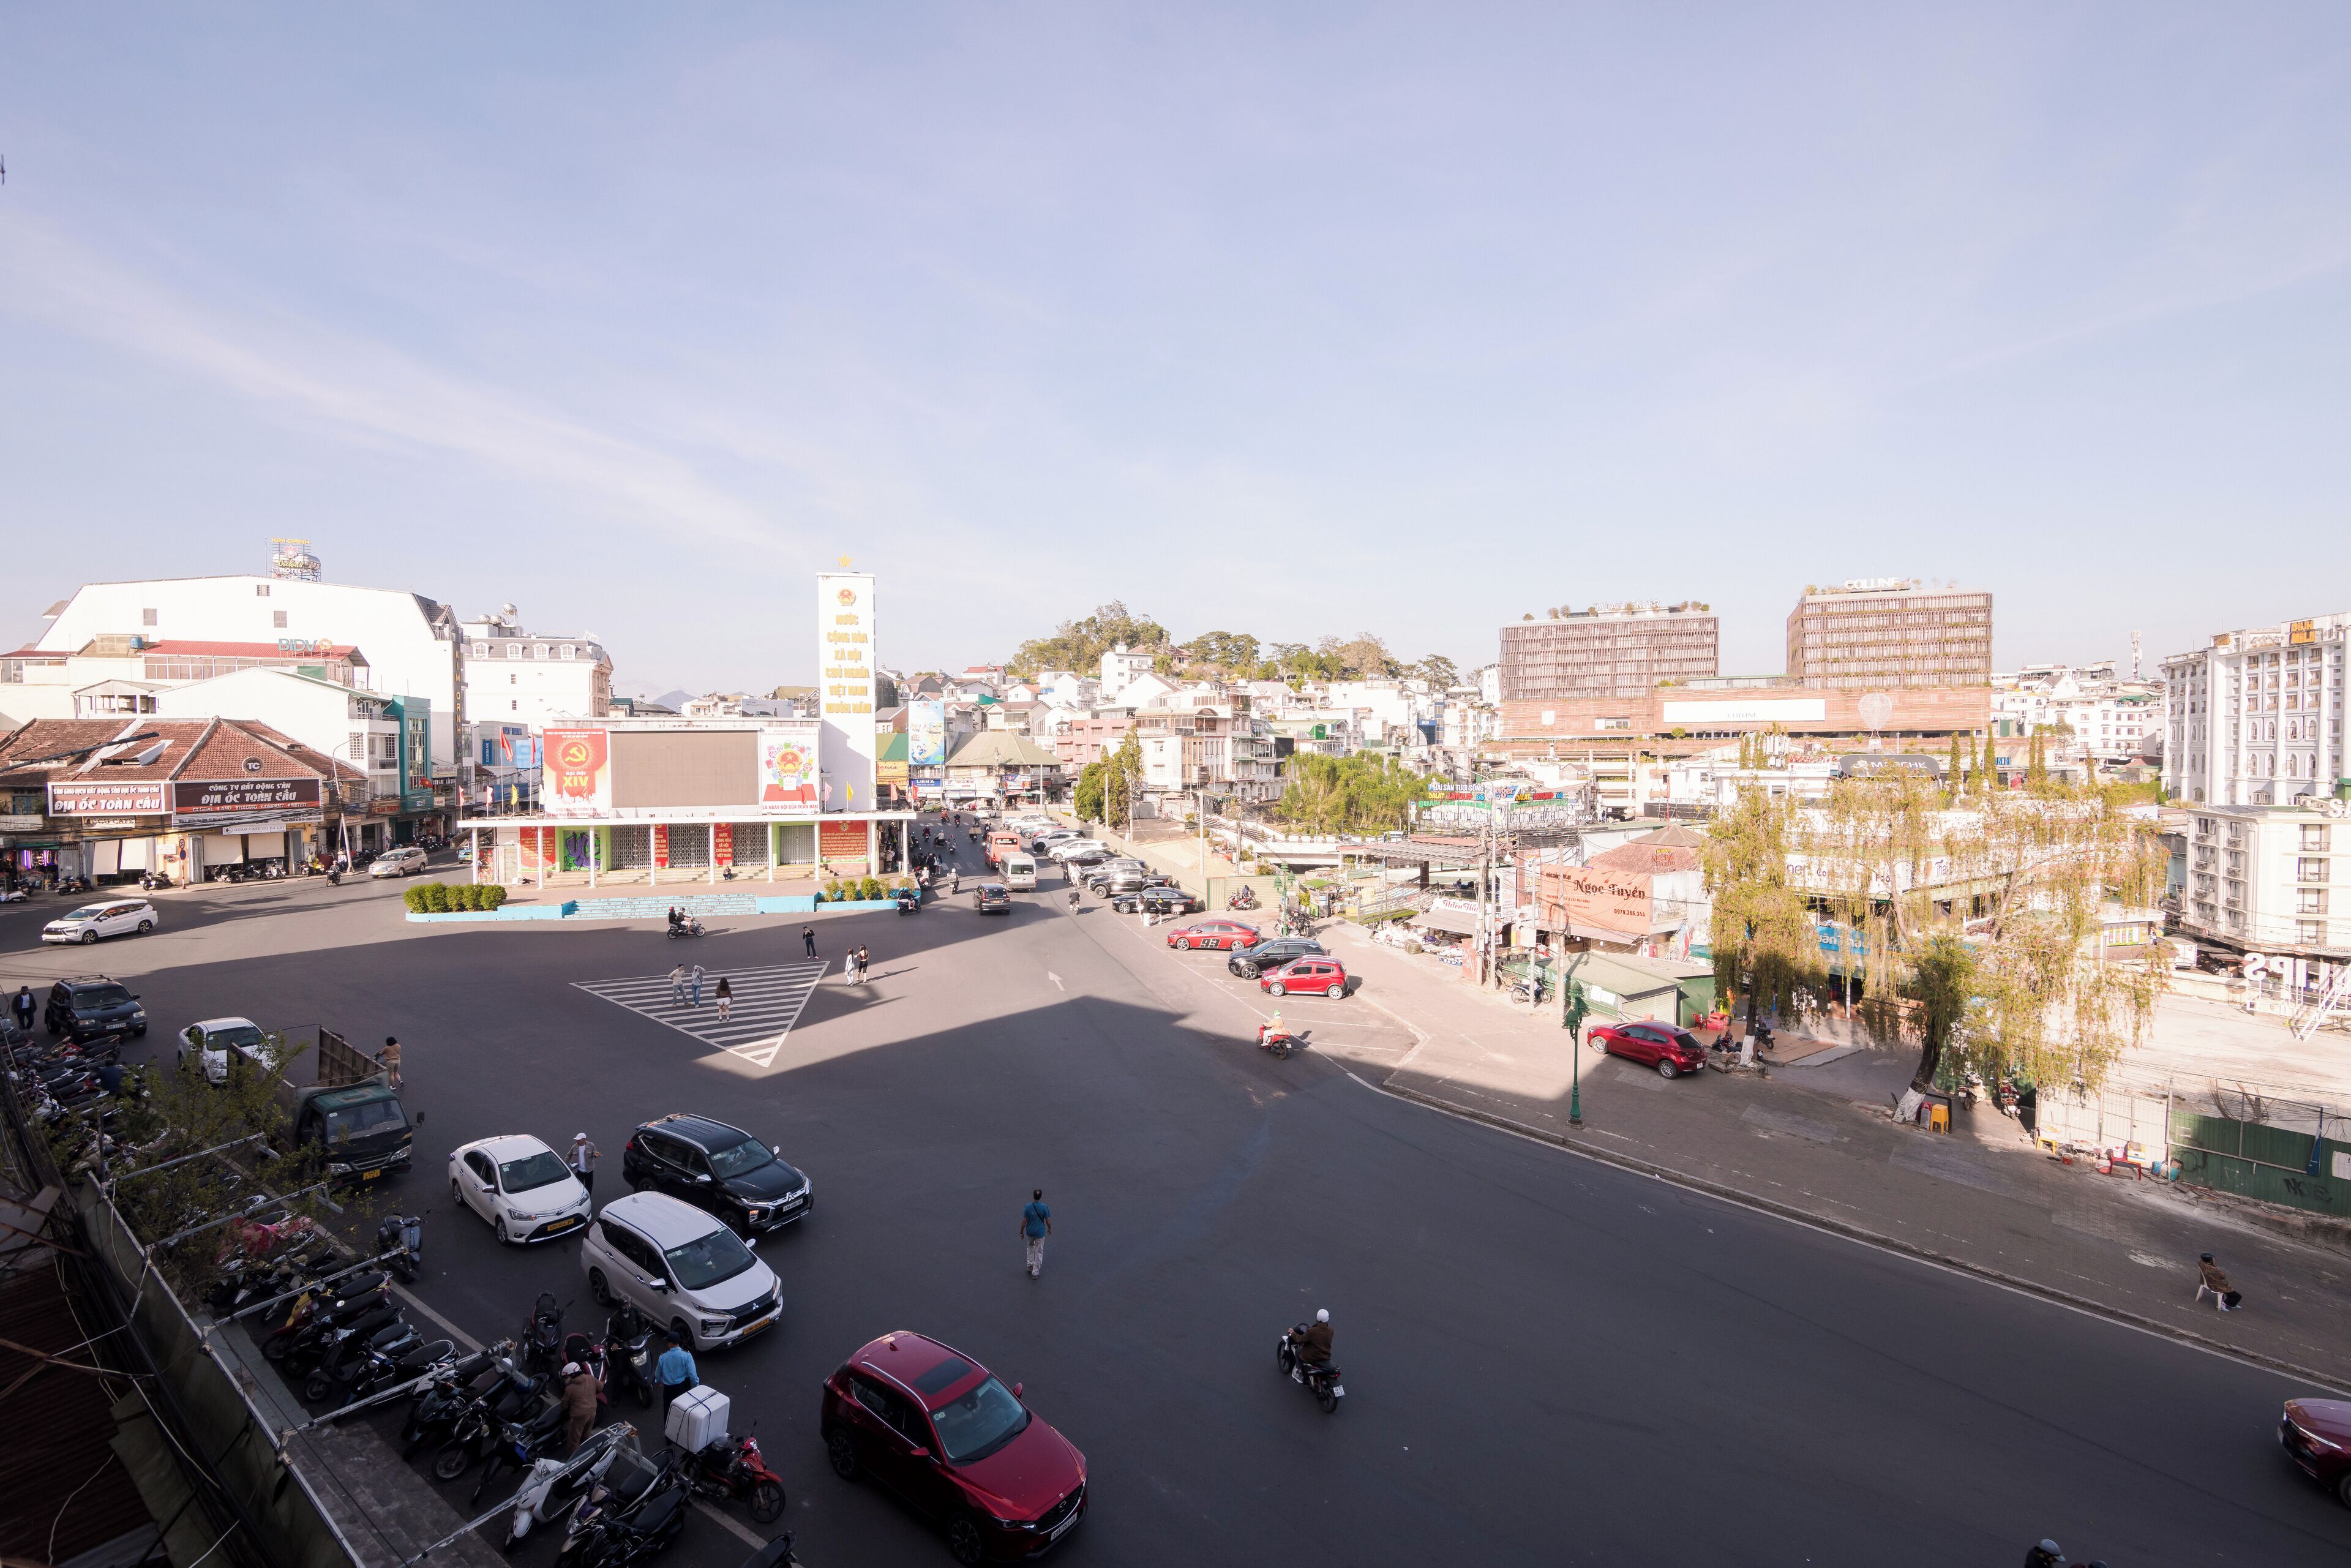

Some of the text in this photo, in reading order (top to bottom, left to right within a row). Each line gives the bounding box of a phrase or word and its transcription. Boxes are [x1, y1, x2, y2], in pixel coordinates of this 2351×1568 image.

[827, 630, 868, 645] CỘNG HÒA
[279, 638, 318, 651] BIDV
[834, 648, 861, 662] XÃ HỘI
[841, 666, 867, 678] NGHĨA
[827, 683, 864, 697] VIỆT NAM
[826, 701, 872, 714] MUÔN NĂM
[563, 776, 589, 787] XIV
[54, 796, 162, 812] ĐỊA ỐC TOÀN CẦU
[201, 789, 297, 806] ĐỊA ỐC TOÀN CẦU
[1574, 880, 1645, 901] Ngọc Tuyền
[1614, 909, 1646, 918] 0979.366.344
[1200, 939, 1221, 948] 93
